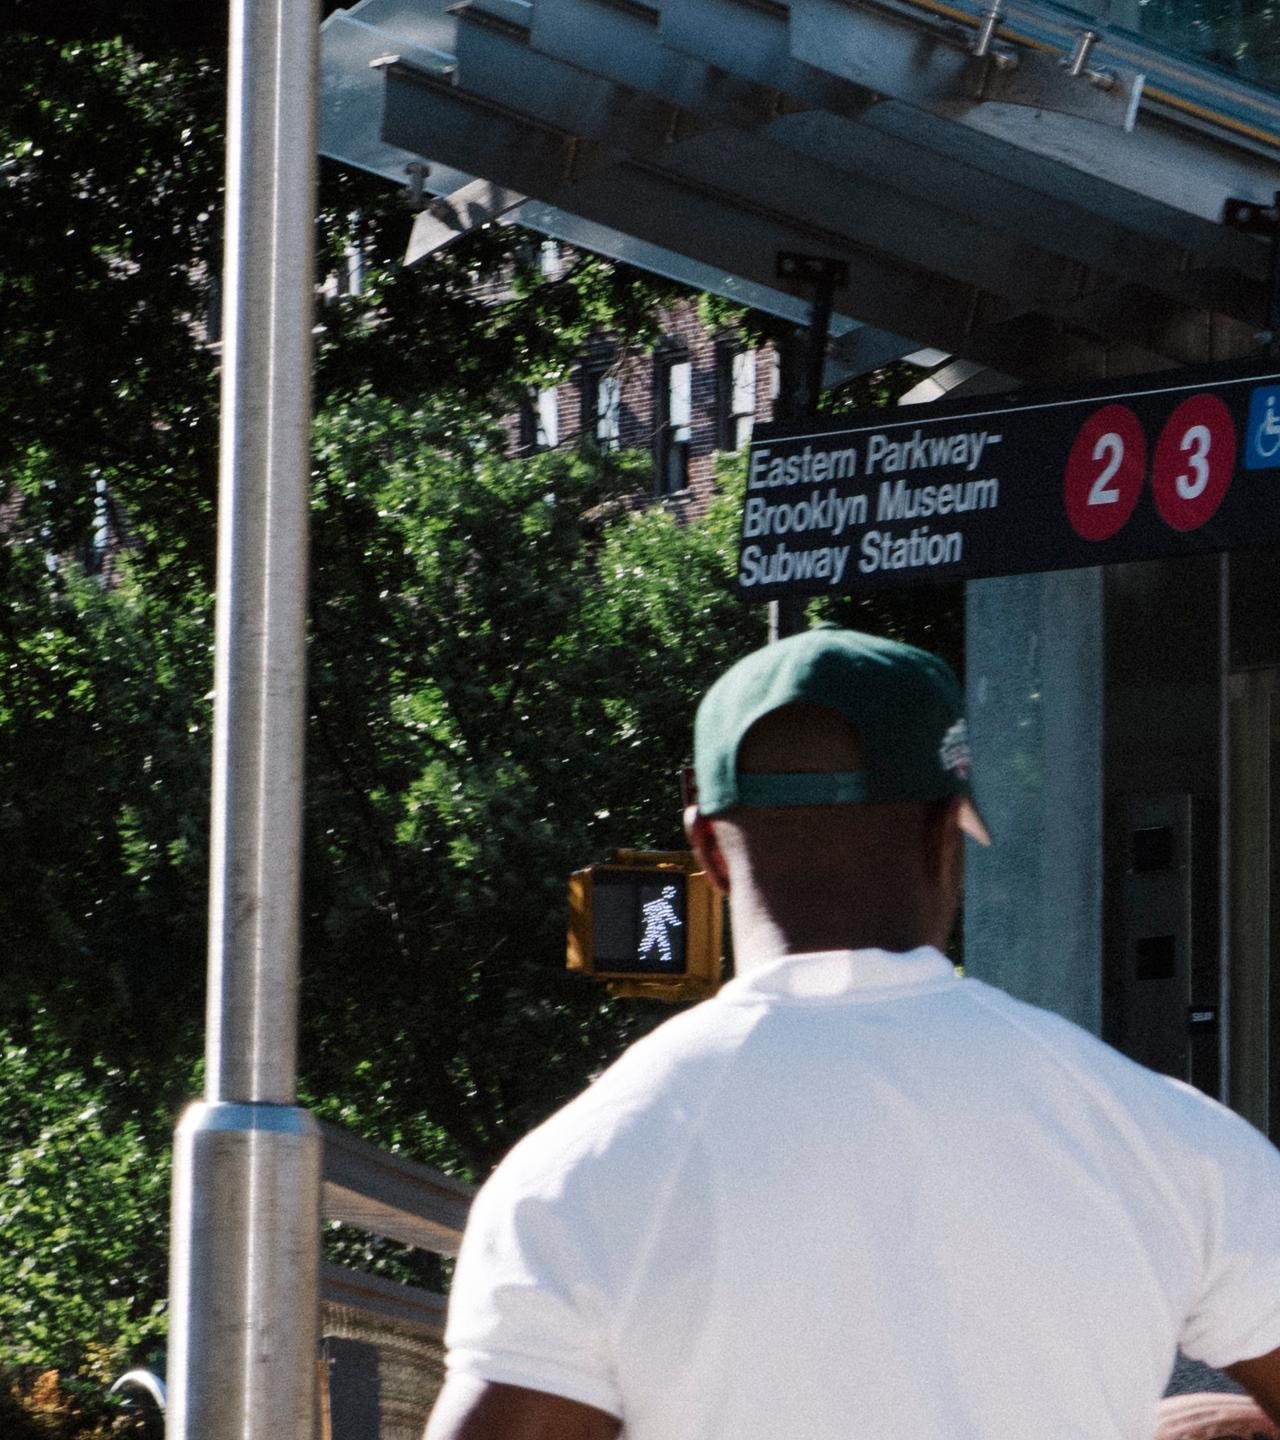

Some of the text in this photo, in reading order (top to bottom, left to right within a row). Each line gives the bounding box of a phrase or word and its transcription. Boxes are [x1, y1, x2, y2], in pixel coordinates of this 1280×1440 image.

[748, 445, 857, 490] Eastern
[1086, 424, 1212, 506] 2 3
[743, 478, 999, 538] Brooklyn Museum
[739, 525, 964, 587] Subway Station
